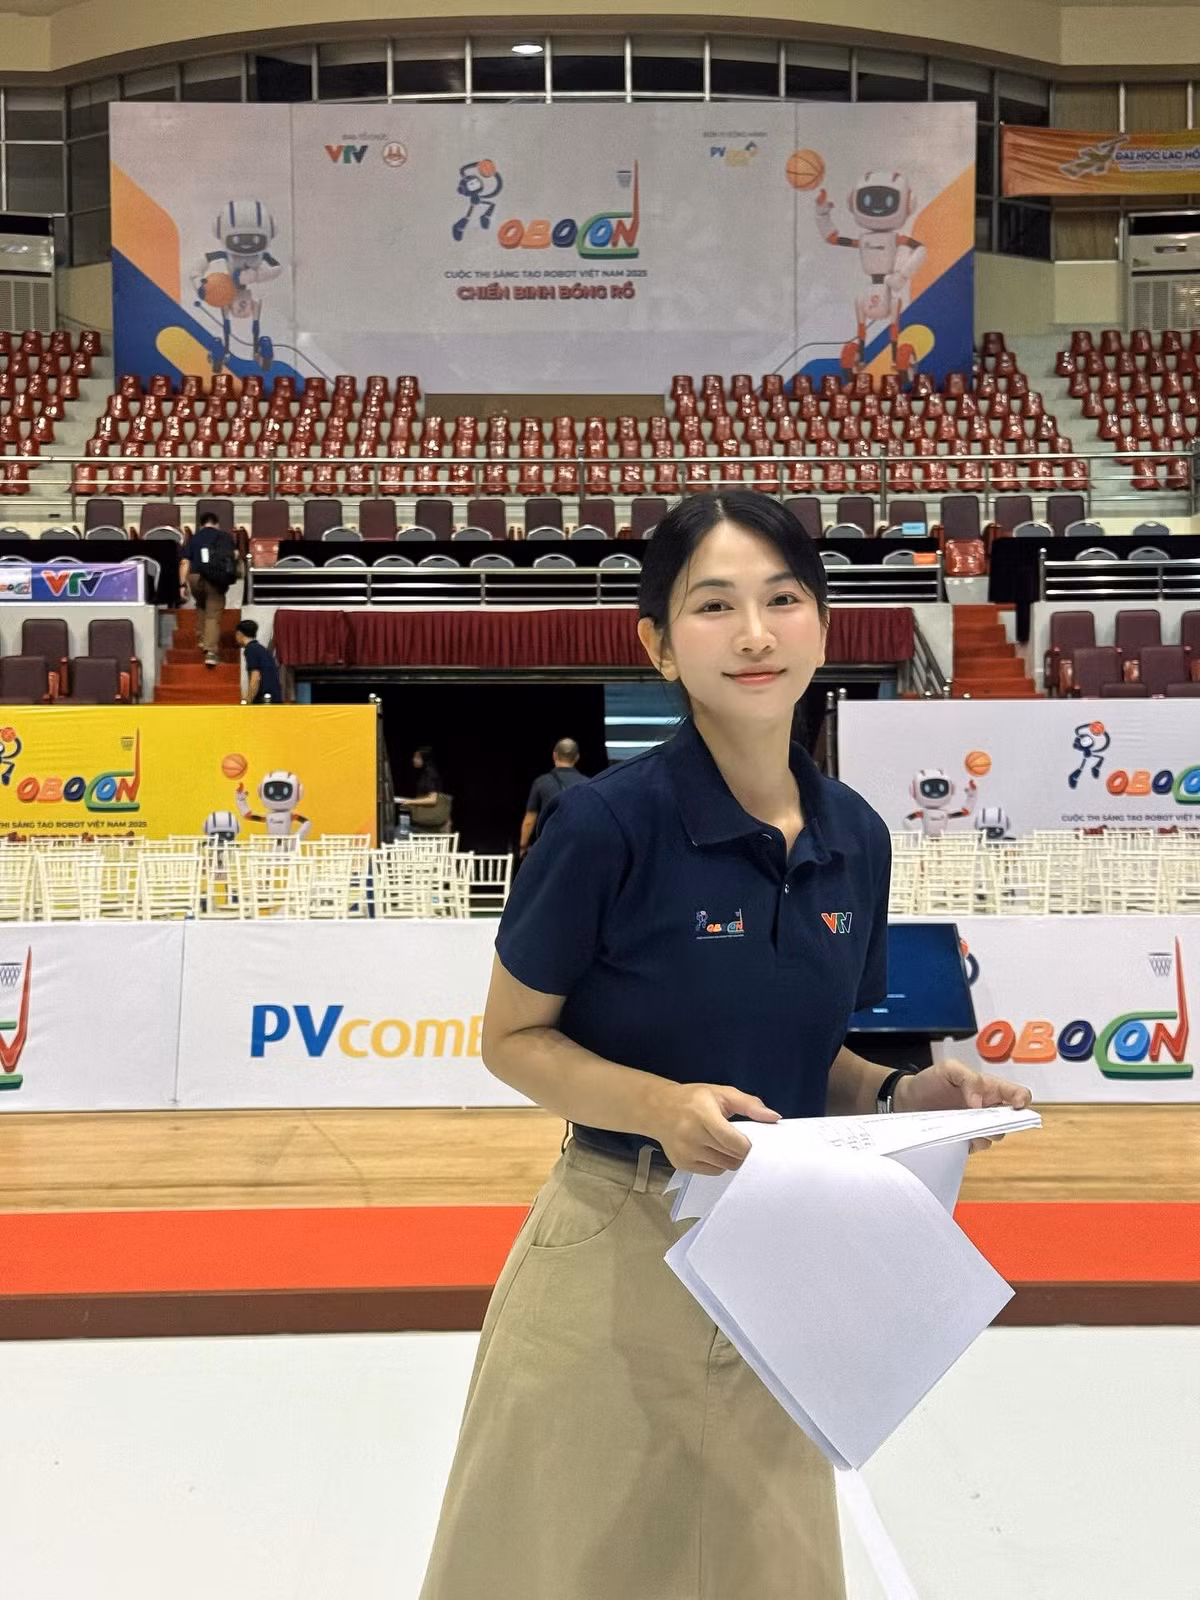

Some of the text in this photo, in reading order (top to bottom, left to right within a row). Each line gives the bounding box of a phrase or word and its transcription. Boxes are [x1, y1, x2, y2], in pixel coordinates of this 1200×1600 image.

[324, 144, 368, 164] VTV
[543, 270, 577, 279] ROBOT
[601, 269, 624, 277] NAM
[513, 285, 556, 300] BINH
[559, 282, 608, 300] BÓNG
[41, 569, 105, 597] VTV
[127, 820, 147, 828] 2025
[1145, 814, 1173, 822] ROBOT
[820, 912, 853, 934] VTV
